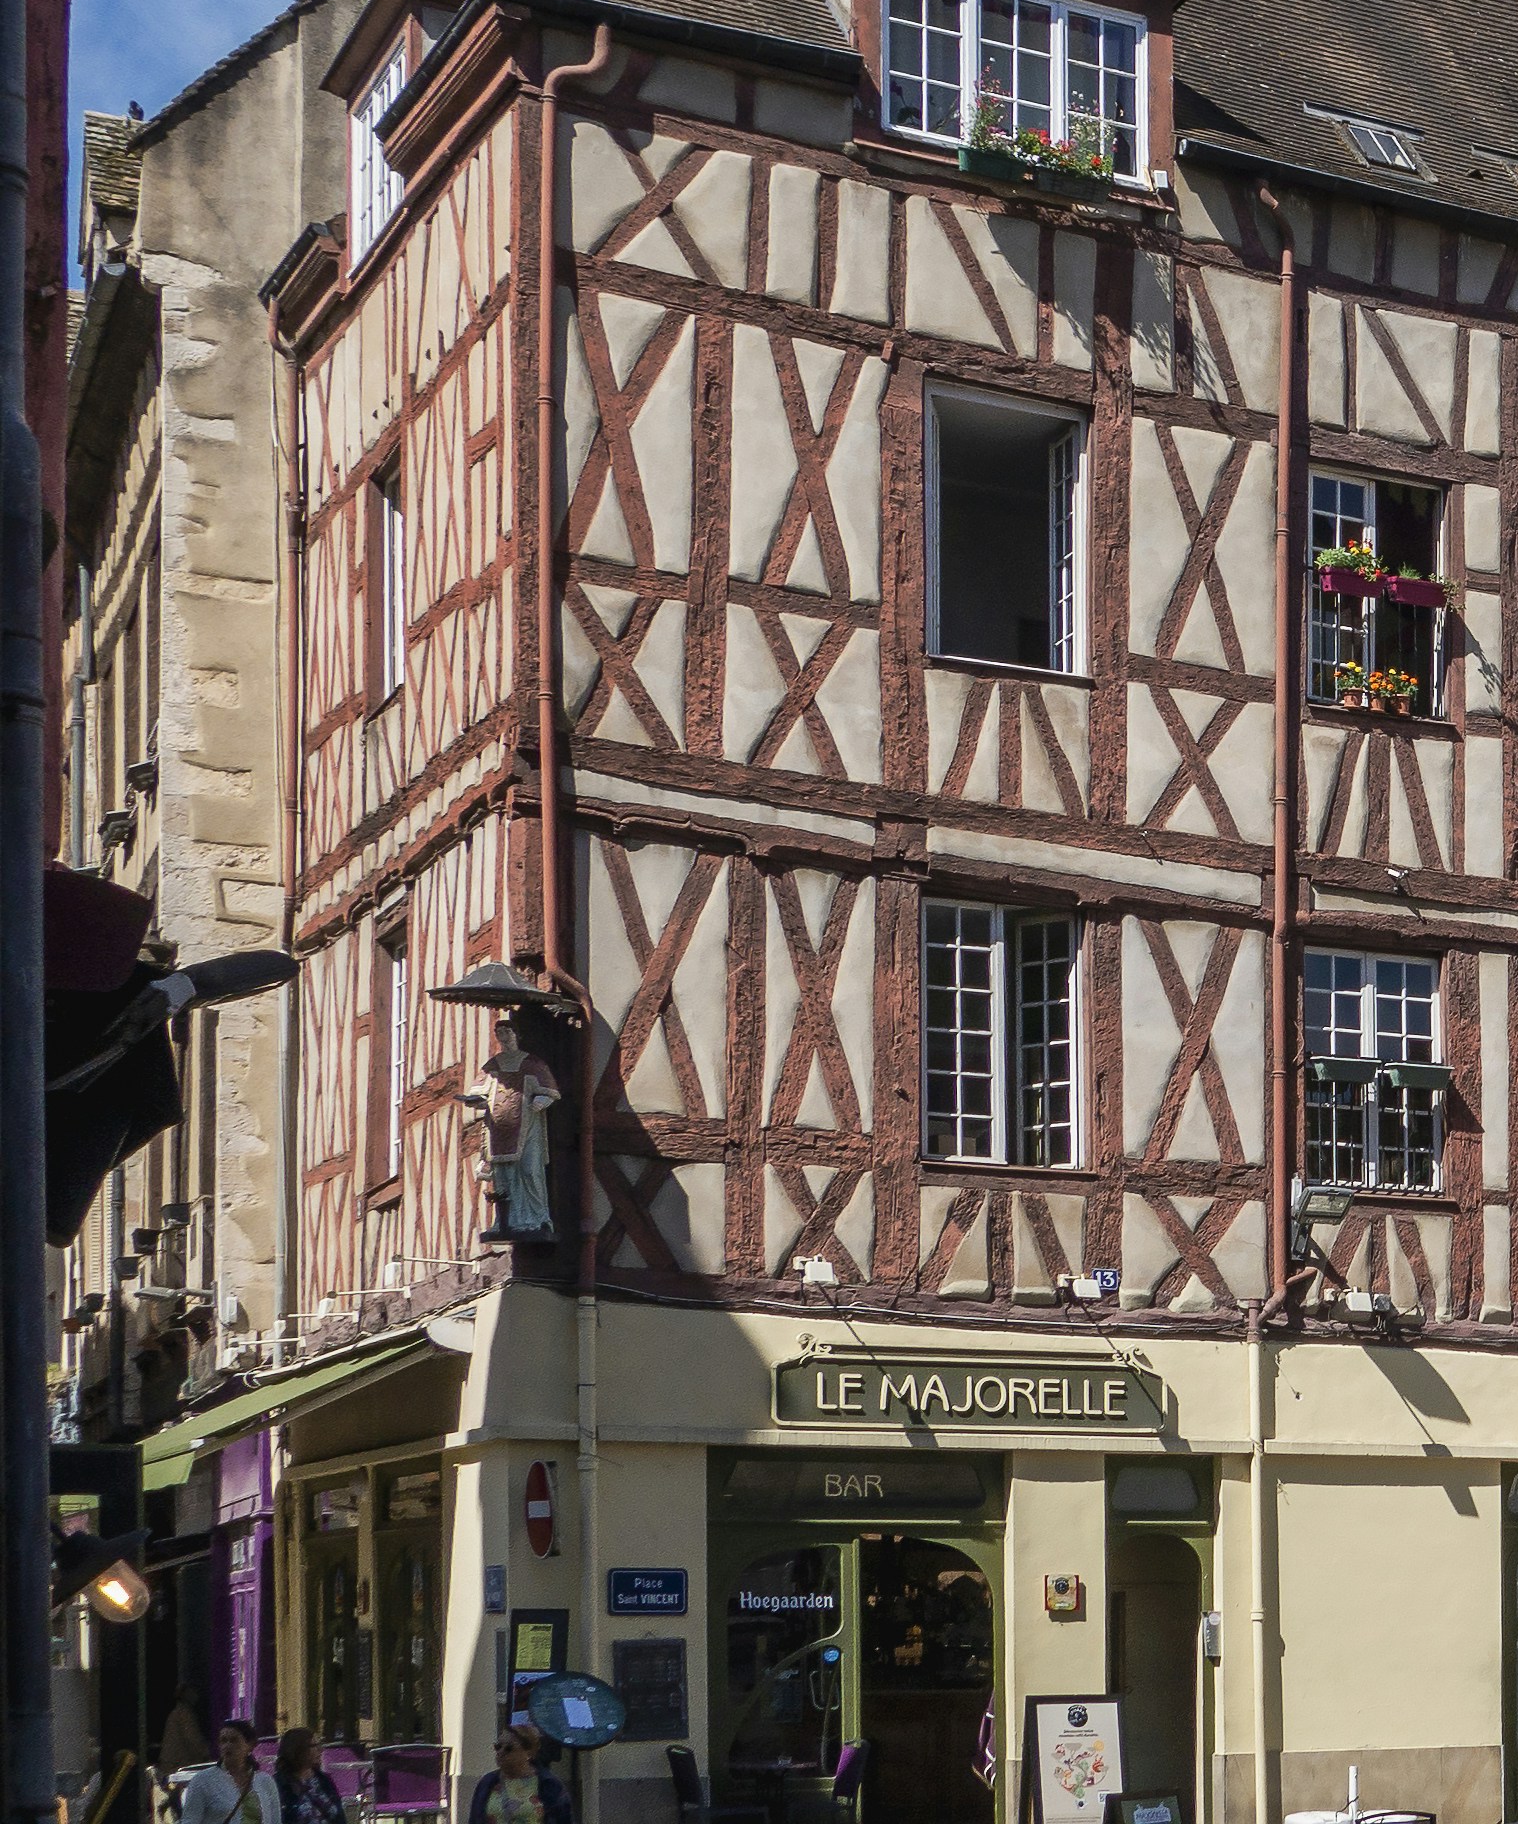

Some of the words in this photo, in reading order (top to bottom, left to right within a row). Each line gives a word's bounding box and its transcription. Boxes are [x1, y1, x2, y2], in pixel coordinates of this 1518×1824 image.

[1096, 1271, 1115, 1287] 13
[816, 1371, 864, 1411] LE
[879, 1373, 1127, 1416] MAJORELLE
[824, 1473, 884, 1498] BAR
[634, 1577, 664, 1589] Place
[641, 1593, 680, 1605] VINCENT
[739, 1591, 834, 1612] Hoegaarden
